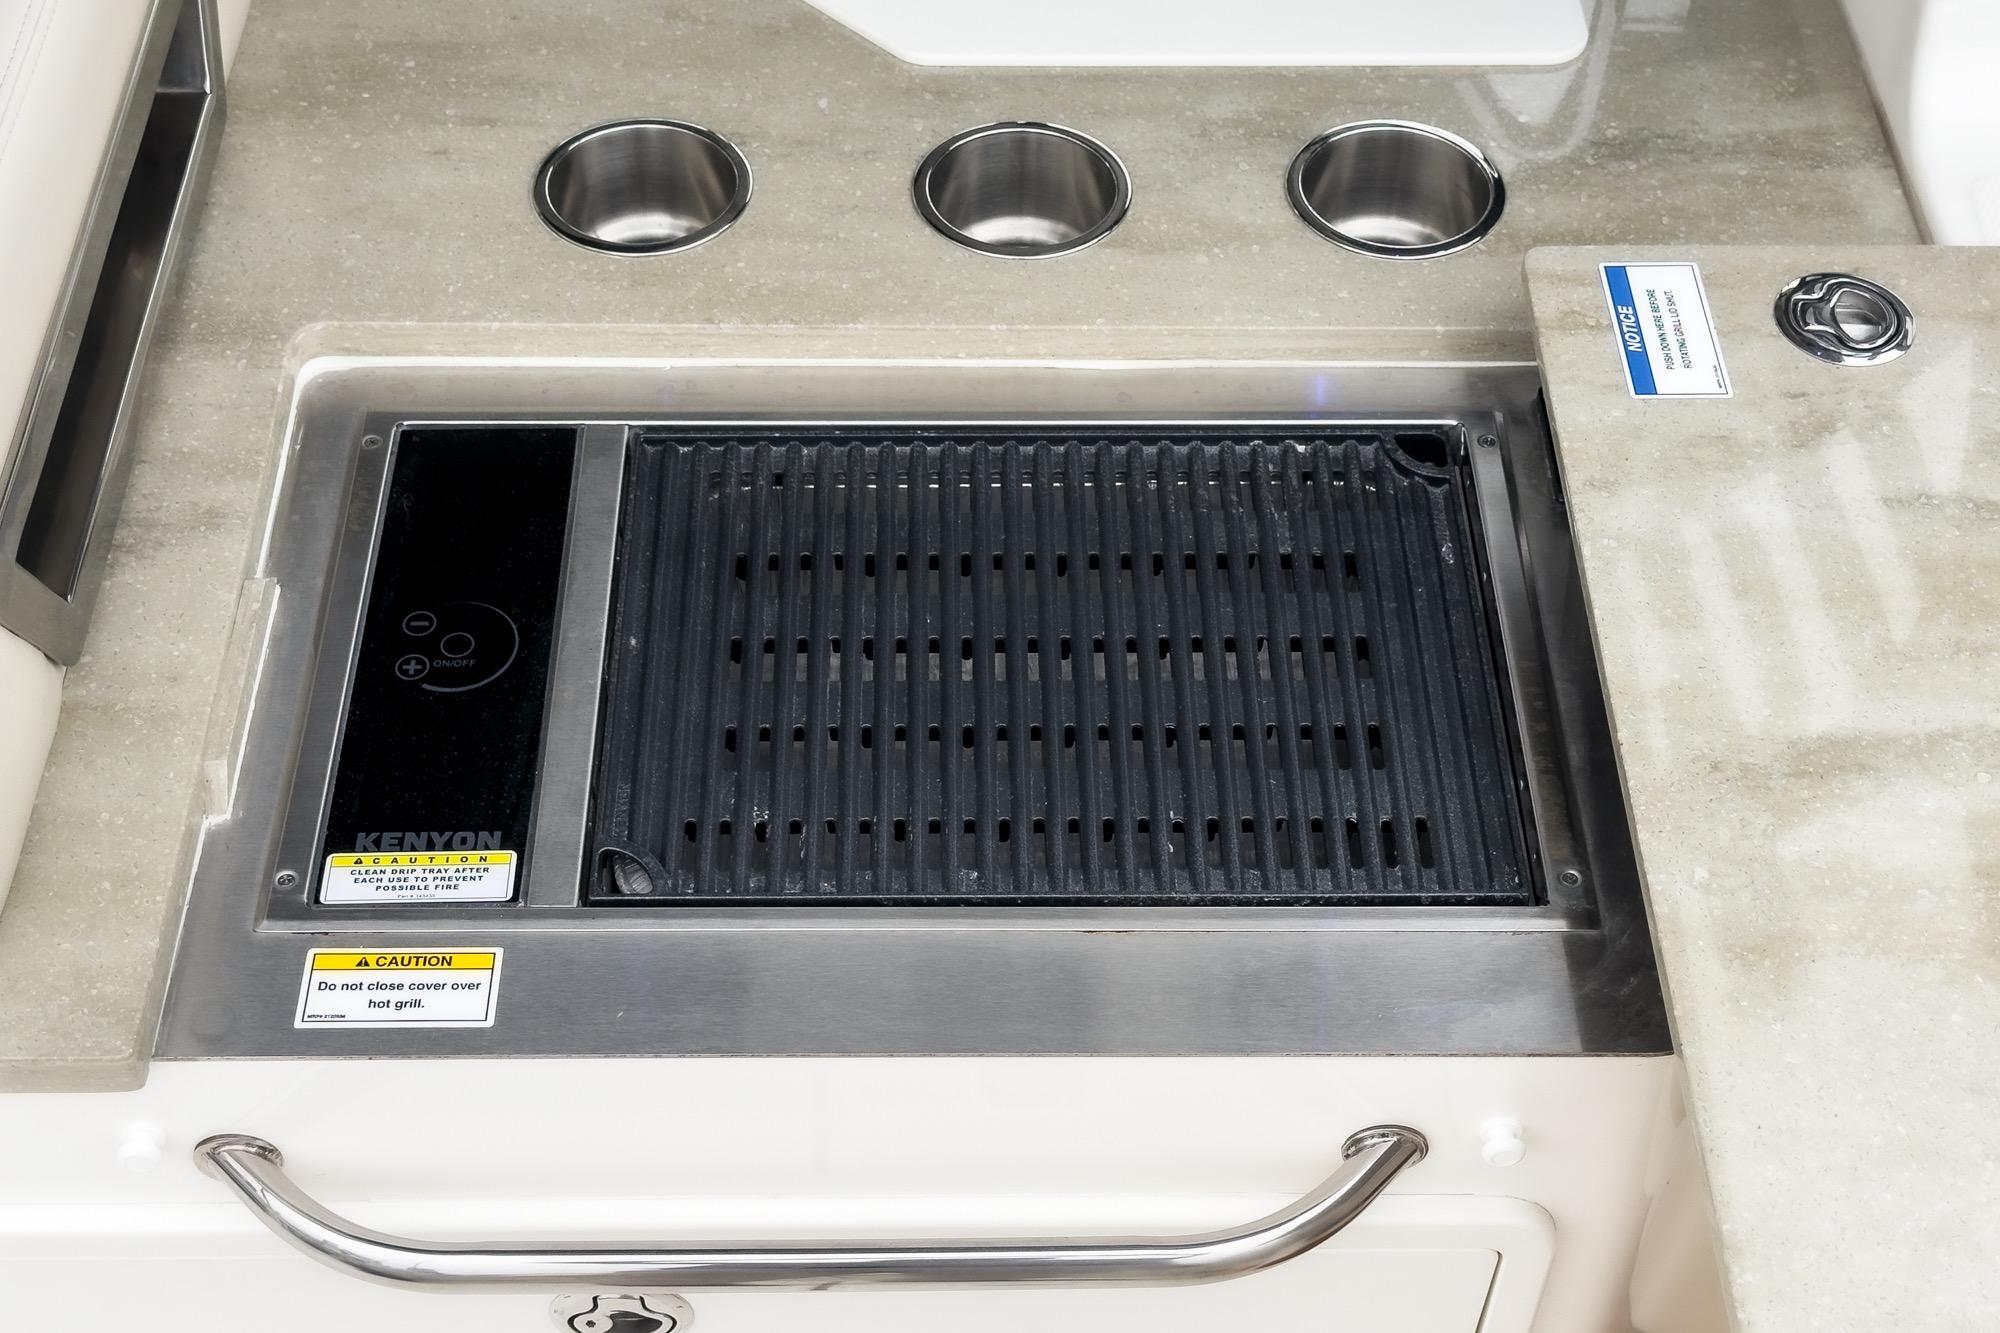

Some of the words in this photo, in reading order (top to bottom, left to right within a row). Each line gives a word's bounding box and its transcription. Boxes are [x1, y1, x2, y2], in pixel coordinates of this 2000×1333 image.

[1646, 288, 1660, 313] BEFORE
[1668, 307, 1679, 318] LID
[1617, 305, 1643, 352] NOTICE
[1653, 314, 1665, 331] HERE
[1671, 319, 1684, 337] GRILL
[1658, 332, 1671, 352] DOWN
[1677, 337, 1693, 369] ROTATING
[1662, 352, 1675, 370] PUSH
[433, 660, 477, 668] ON/OFF
[355, 831, 502, 851] KENYON
[372, 854, 488, 865] CAUTION
[350, 868, 387, 876] CLEAN
[421, 867, 450, 875] TRAY
[454, 866, 490, 874] AFTER
[375, 884, 430, 892] POSSIBLE
[375, 955, 453, 968] CAUTION
[317, 981, 337, 991] Do
[341, 981, 363, 991] not
[367, 980, 404, 991] close
[408, 982, 447, 991] cover
[451, 982, 482, 991] over
[368, 998, 391, 1009] hot
[394, 998, 425, 1011] grill.
